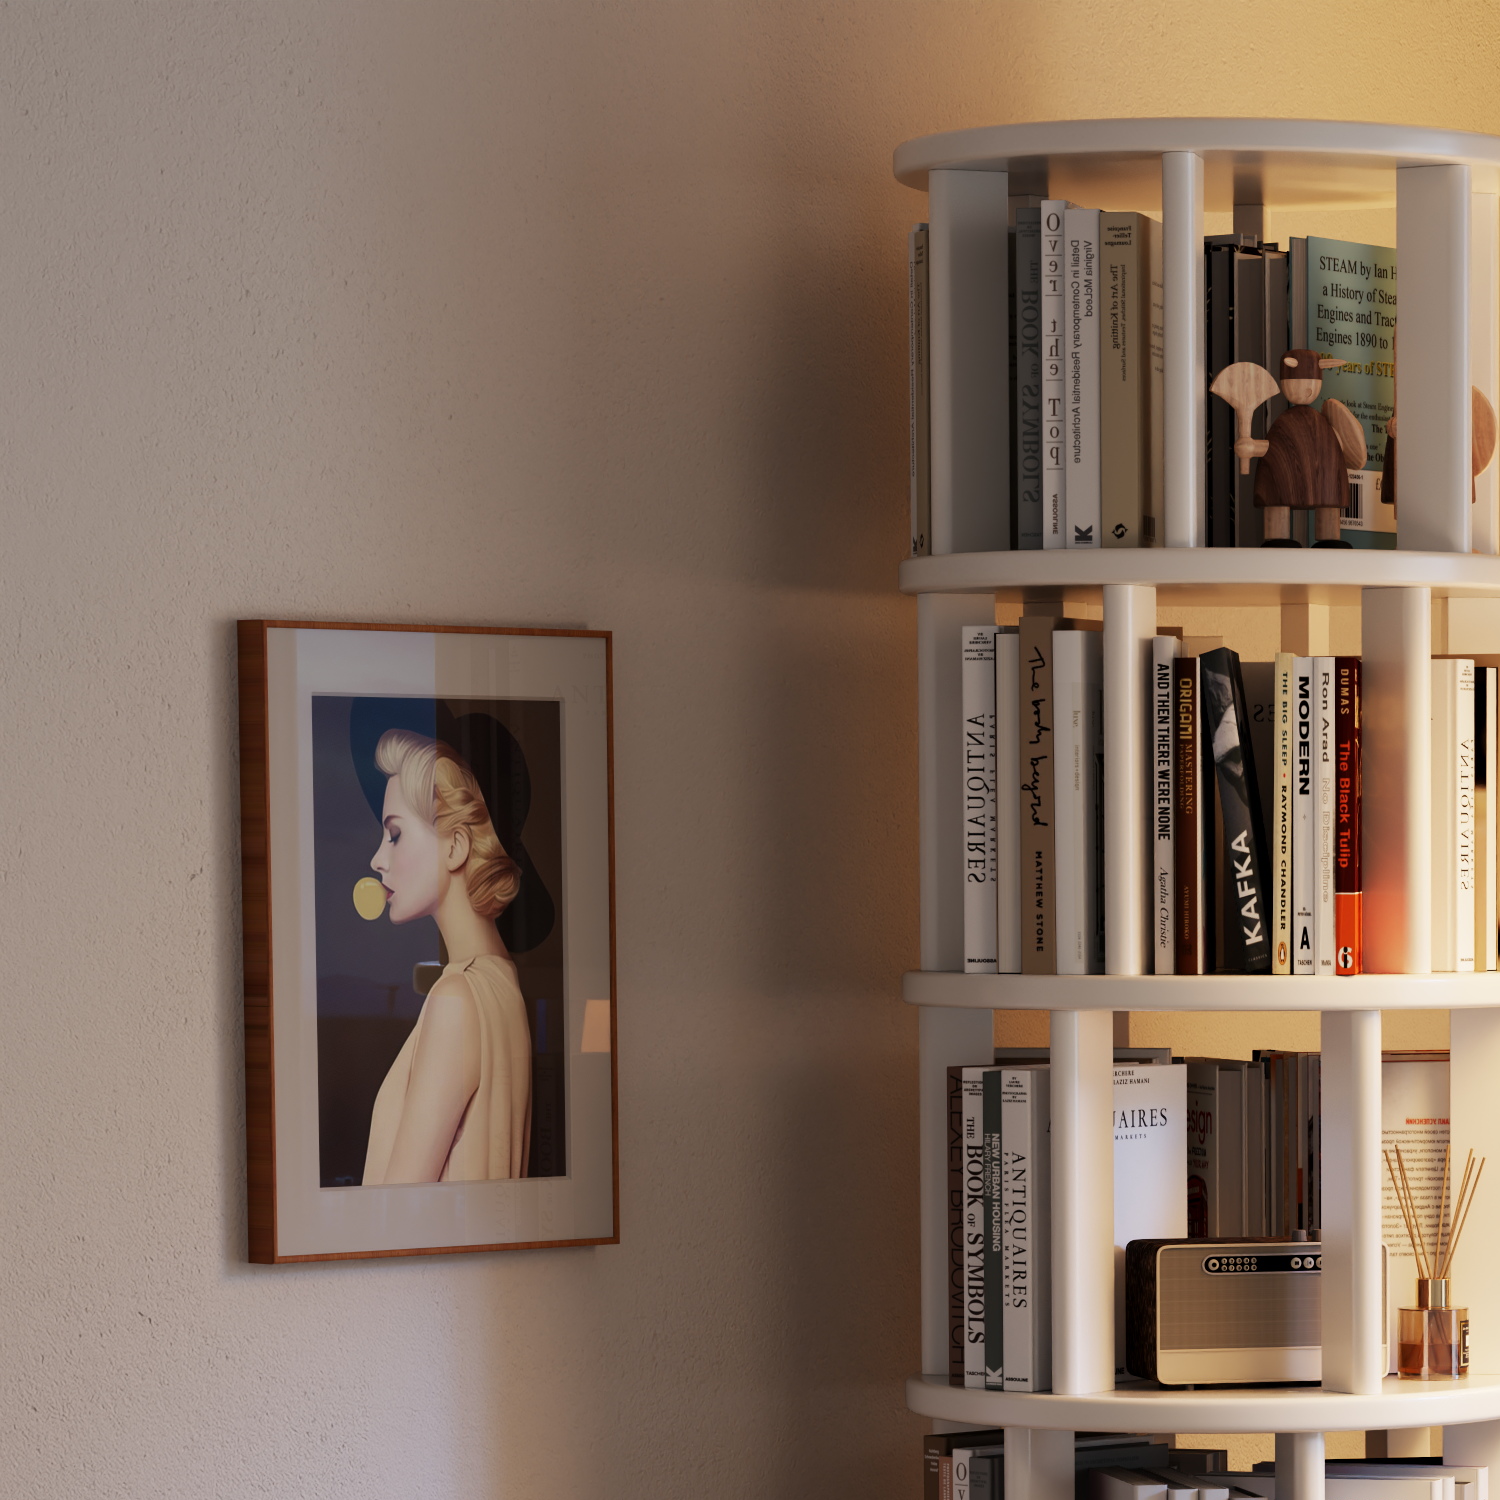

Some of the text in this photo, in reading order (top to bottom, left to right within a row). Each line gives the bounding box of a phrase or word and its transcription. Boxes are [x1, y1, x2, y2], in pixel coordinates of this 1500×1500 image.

[1319, 255, 1388, 281] STEAM by Ian
[1322, 285, 1329, 297] a
[1331, 282, 1364, 305] History
[1366, 288, 1378, 303] of
[1316, 326, 1389, 350] Engines 1890 to
[1317, 303, 1372, 325] Engines and
[1364, 360, 1376, 376] of
[1371, 423, 1385, 435] The
[1322, 671, 1331, 711] Ron
[1021, 646, 1051, 827] The body beyond
[1157, 663, 1171, 841] AND THEN THERE WERE NONE
[1179, 677, 1193, 815] ORIGAMI MASTERING
[1298, 675, 1310, 796] MODERN
[1322, 717, 1331, 763] Arad
[1338, 668, 1351, 869] DUMAS The Black Tulip
[1230, 829, 1263, 946] KAFKA
[1319, 810, 1331, 903] Discipline
[1035, 850, 1044, 952] MATTHEW STONE
[1158, 867, 1170, 949] Agatha Christie
[1129, 1077, 1150, 1085] HAMANI
[984, 1132, 992, 1197] HILARY FRENCH
[1114, 1133, 1147, 1141] MARKETS
[966, 1117, 985, 1344] THE BOOK OF SYMBOLS
[991, 1132, 1002, 1252] NEW URBAN HOUSING
[1009, 1151, 1027, 1308] ANTIQUAIRES
